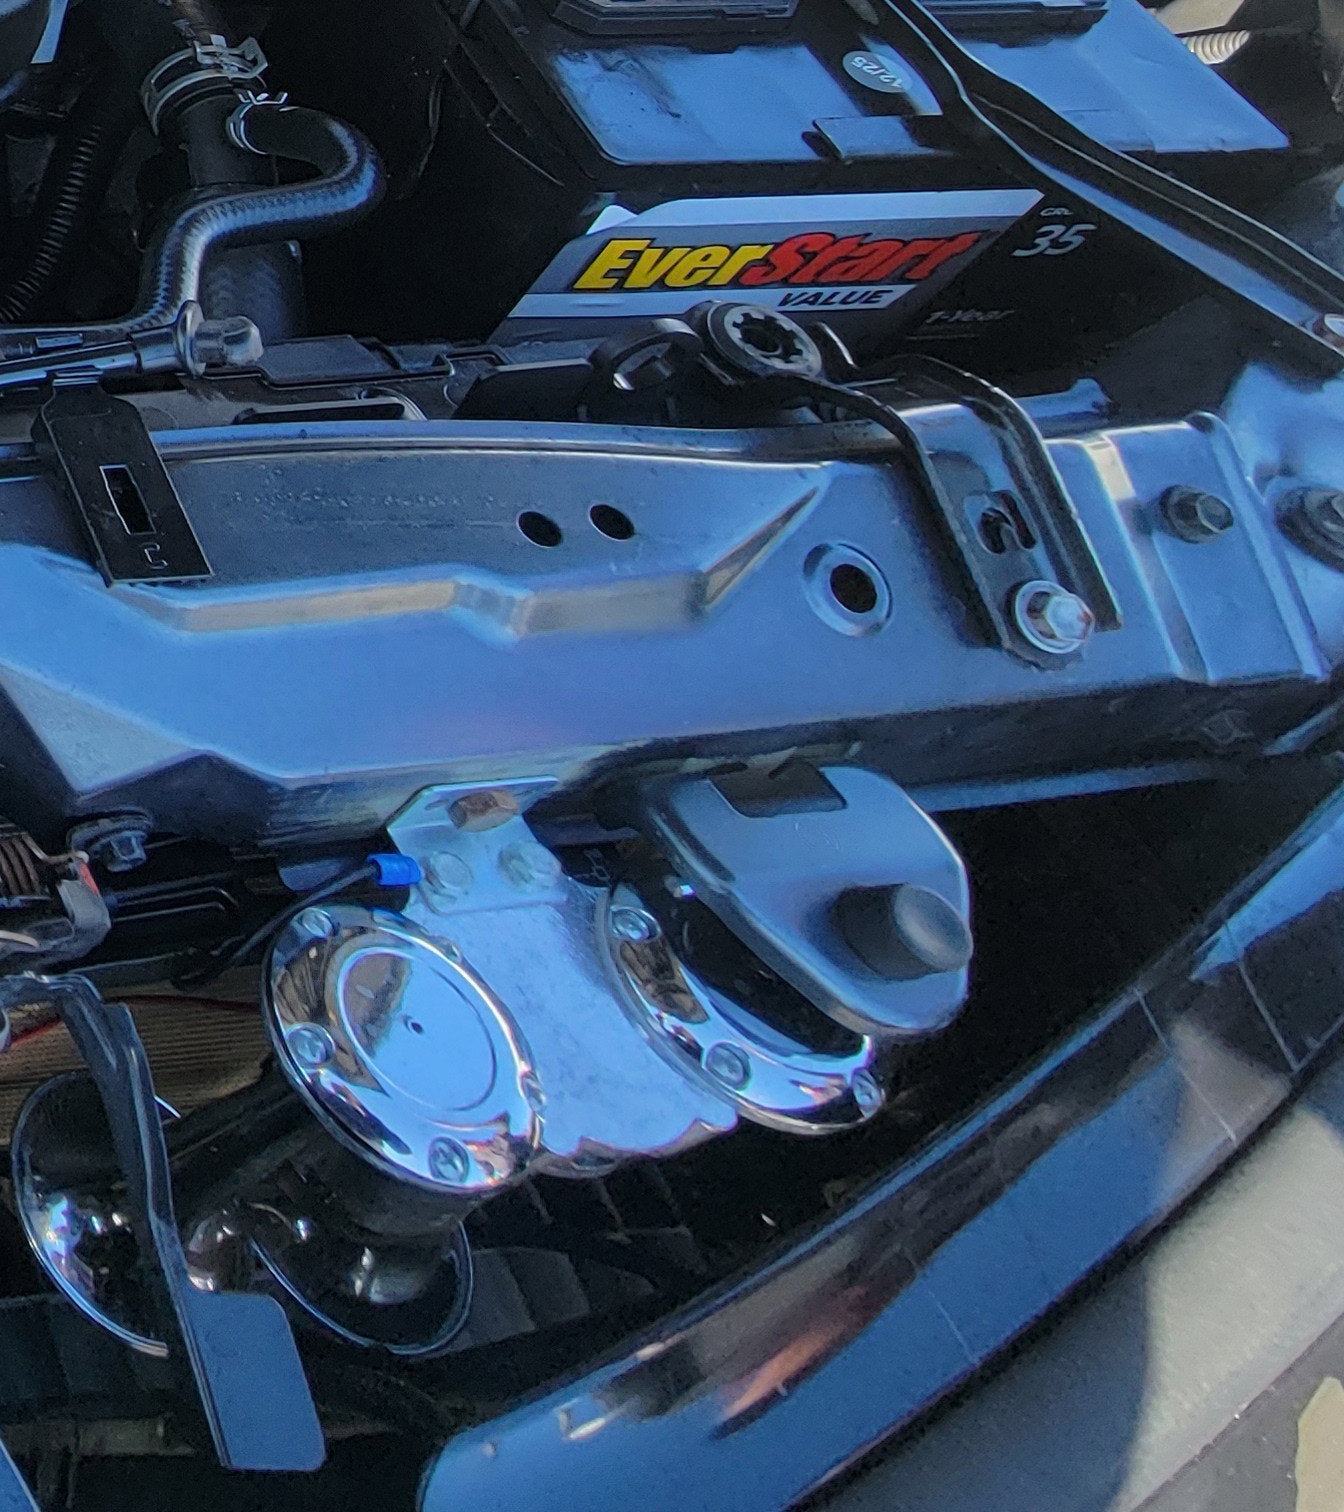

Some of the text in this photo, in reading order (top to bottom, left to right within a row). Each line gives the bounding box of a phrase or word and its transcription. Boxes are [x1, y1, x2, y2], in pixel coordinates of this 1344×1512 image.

[1012, 223, 1099, 257] 35
[573, 232, 982, 289] EverStart
[778, 290, 895, 308] VALUE
